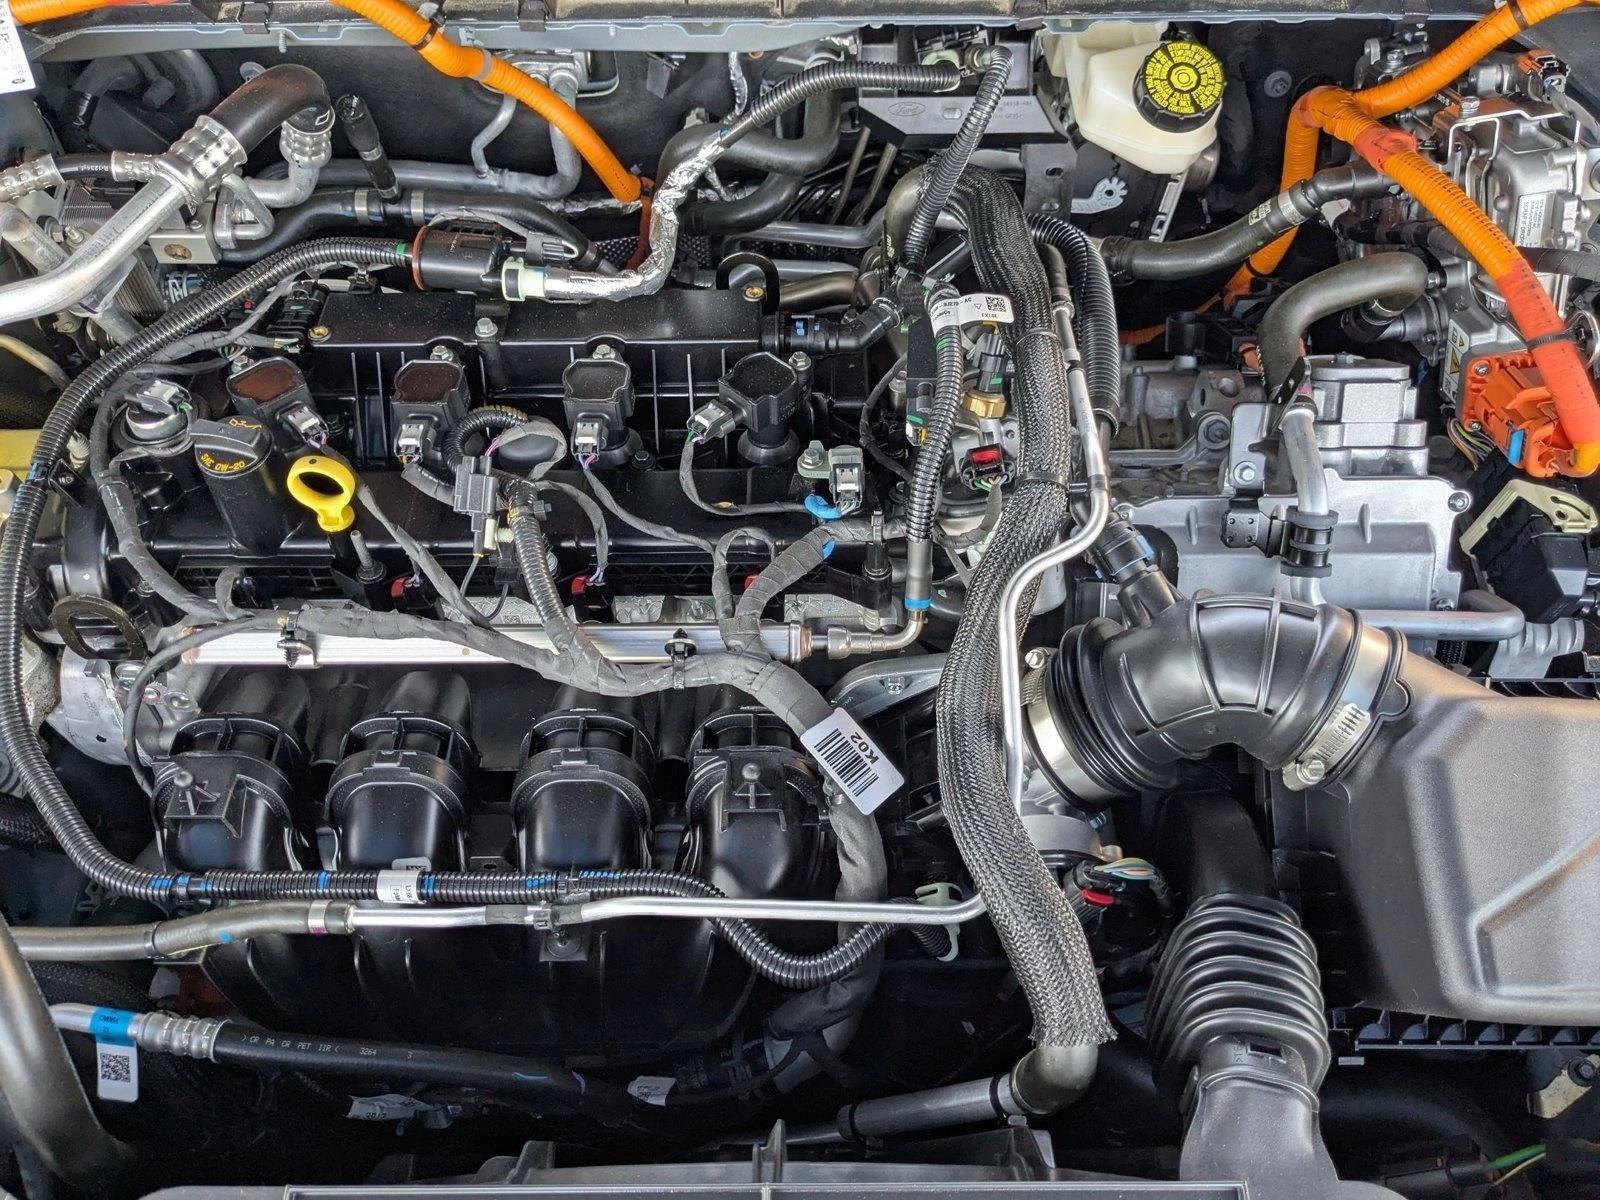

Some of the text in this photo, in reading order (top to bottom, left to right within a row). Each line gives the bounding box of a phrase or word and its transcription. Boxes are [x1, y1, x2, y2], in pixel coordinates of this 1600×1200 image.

[201, 453, 246, 472] SAE 0W-20
[850, 731, 880, 765] K02
[297, 1042, 312, 1050] PET
